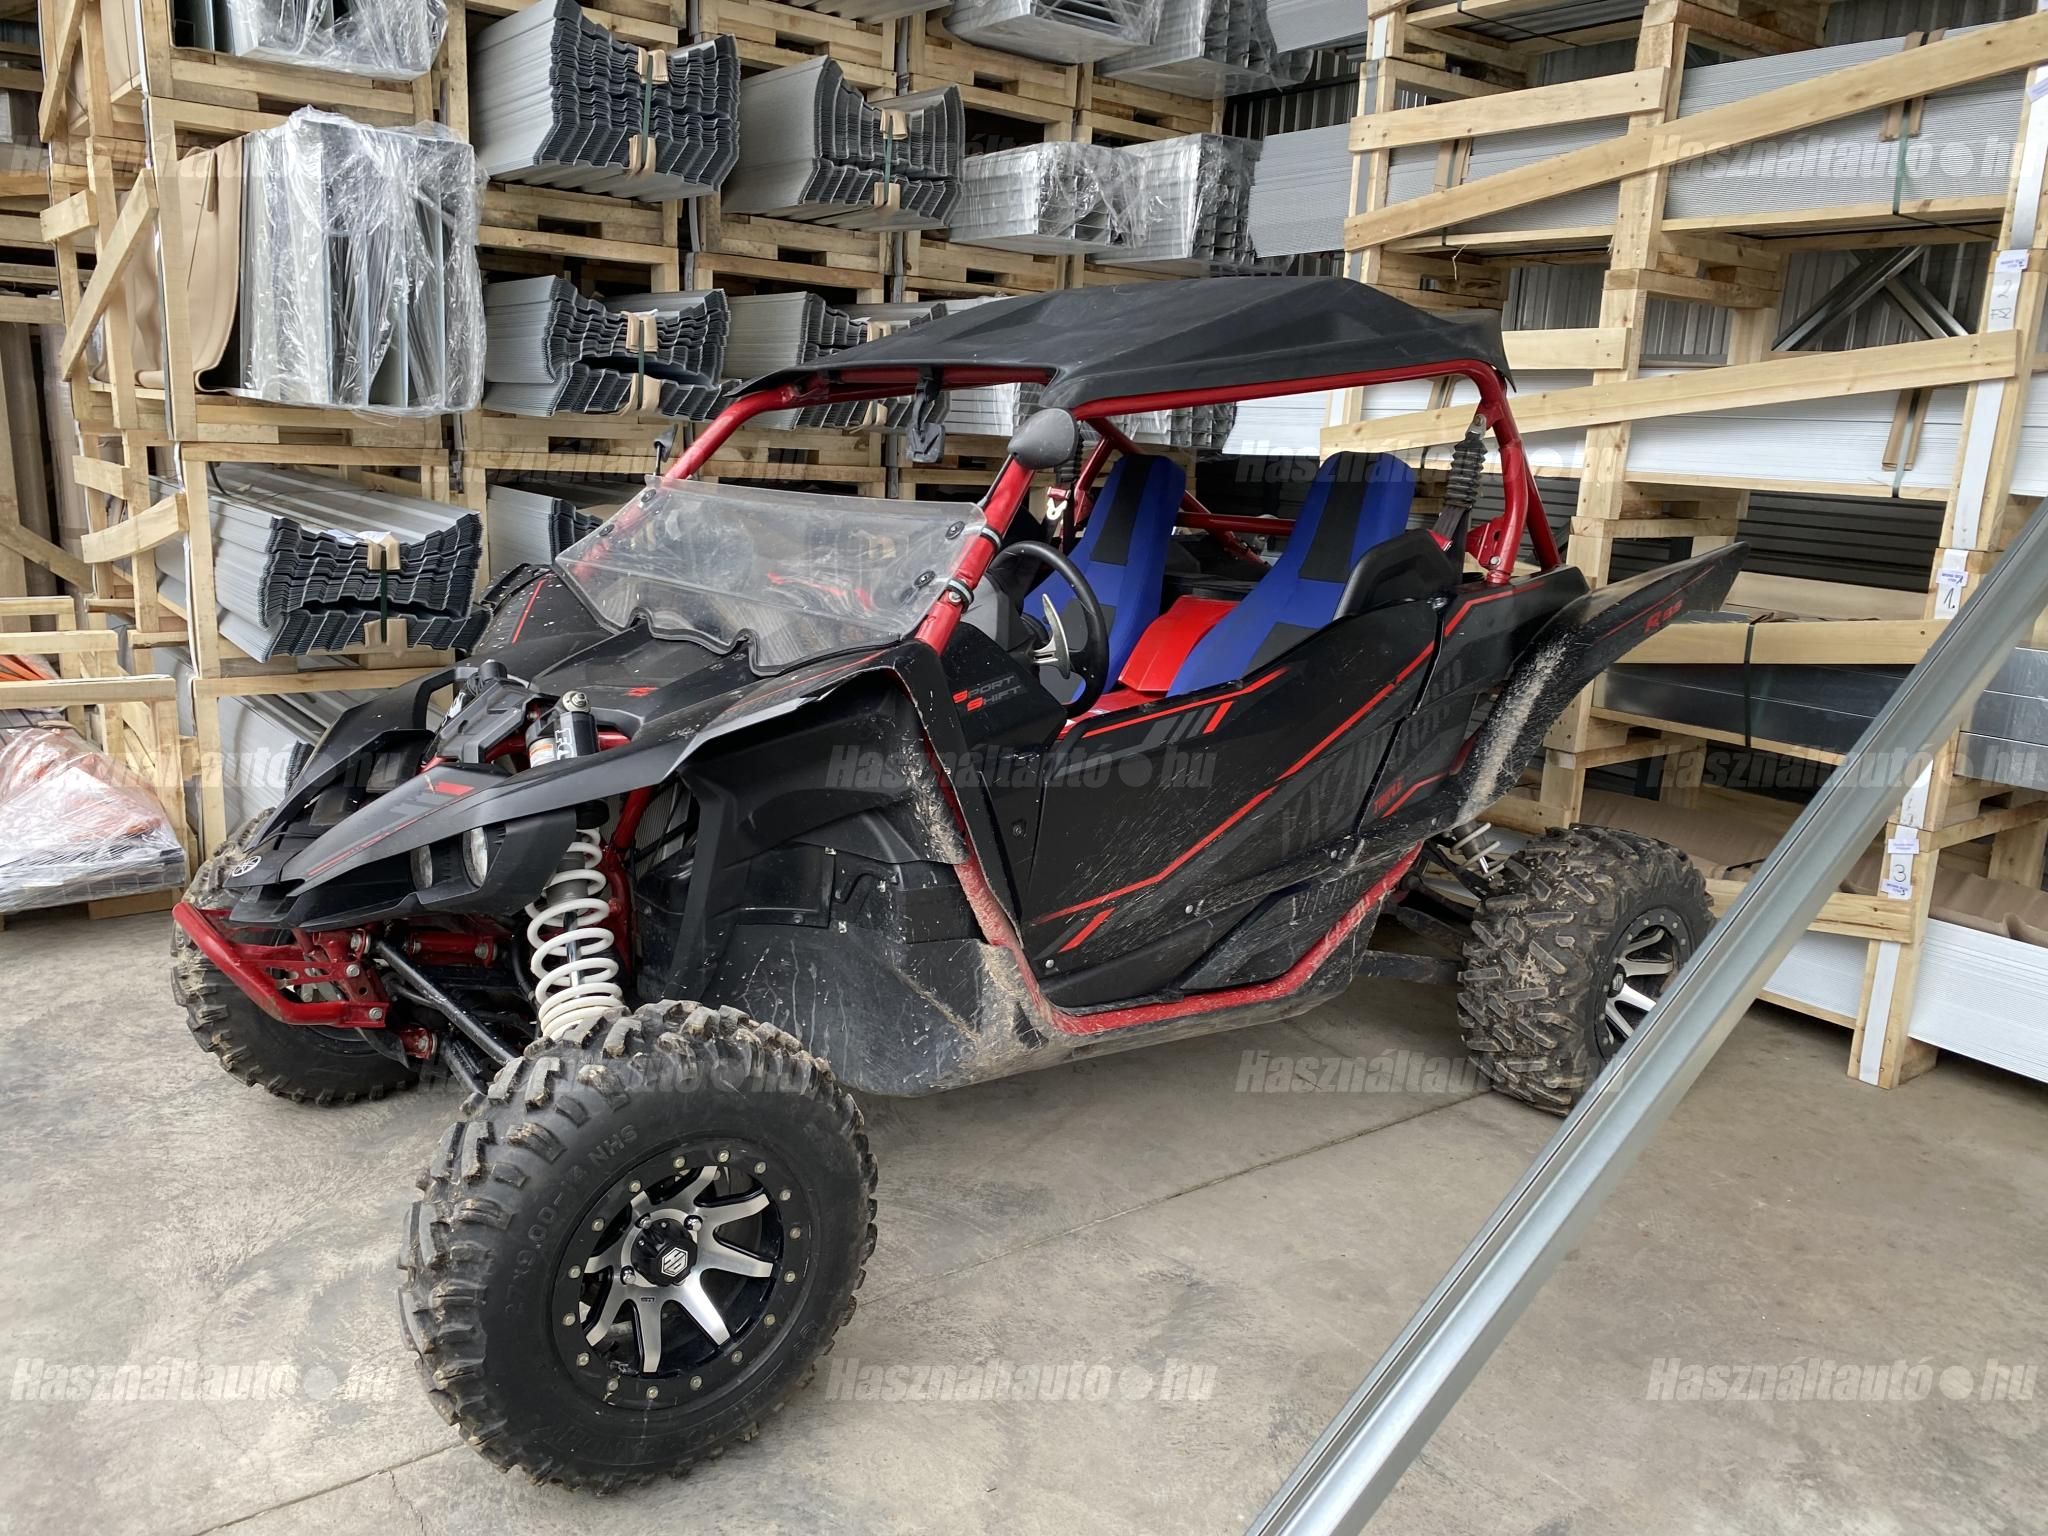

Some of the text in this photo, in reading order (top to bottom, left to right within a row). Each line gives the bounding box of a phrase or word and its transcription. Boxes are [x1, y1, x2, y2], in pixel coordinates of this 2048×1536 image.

[952, 675, 1016, 704] SPORT
[966, 685, 1022, 713] SHIFT
[1893, 864, 1907, 883] 3
[587, 1123, 639, 1167] NHS
